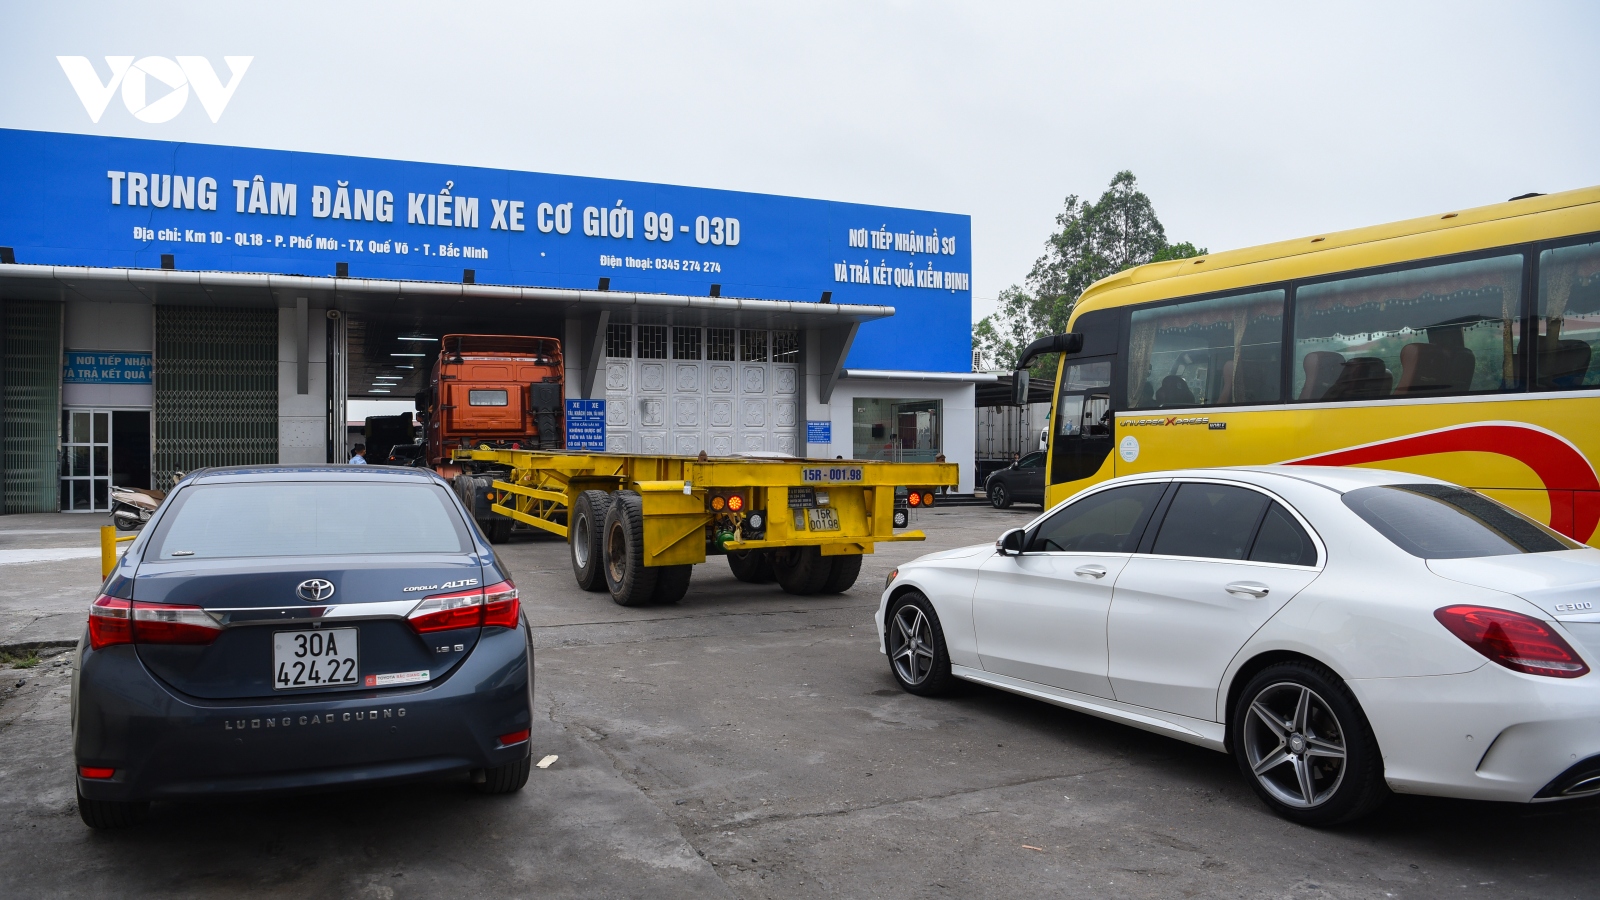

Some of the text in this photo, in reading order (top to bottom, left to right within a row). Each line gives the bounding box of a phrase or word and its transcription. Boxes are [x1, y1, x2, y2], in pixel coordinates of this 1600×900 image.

[107, 170, 741, 246] TRUNG TÂM ĐĂNG KIỂM XE CƠ GIỚI 99 - 03D
[133, 226, 155, 242] Địa
[158, 227, 182, 243] chỉ:
[185, 229, 206, 243] Km
[209, 231, 223, 244] 10
[234, 232, 263, 246] QL18
[275, 235, 286, 248] P.
[289, 234, 313, 249] Phố
[316, 235, 338, 251] Mới
[348, 239, 364, 252] TX
[368, 238, 391, 254] Quế
[394, 240, 408, 254] Võ
[439, 242, 461, 258] Bắc
[463, 245, 488, 259] Ninh
[849, 224, 956, 256] NƠI TIẾP NHẬN HỒ SƠ
[600, 254, 721, 273] Điện thoại: 0345 274 274
[834, 259, 969, 293] VÀ TRẢ KẾT QUẢ KIỂM ĐỊNH
[76, 356, 95, 365] NƠI
[98, 355, 121, 366] TIẾP
[78, 367, 98, 378] TRẢ
[102, 368, 121, 379] KẾT
[124, 367, 146, 379] QUẢ
[803, 470, 822, 480] 15R
[830, 469, 862, 480] 001.98
[810, 520, 838, 530] 001.98
[440, 578, 478, 590] ALTIS
[1566, 602, 1592, 611] 300
[294, 632, 338, 658] 30A
[277, 658, 356, 686] 424.22
[225, 708, 406, 730] LUONG CAO CUONG
